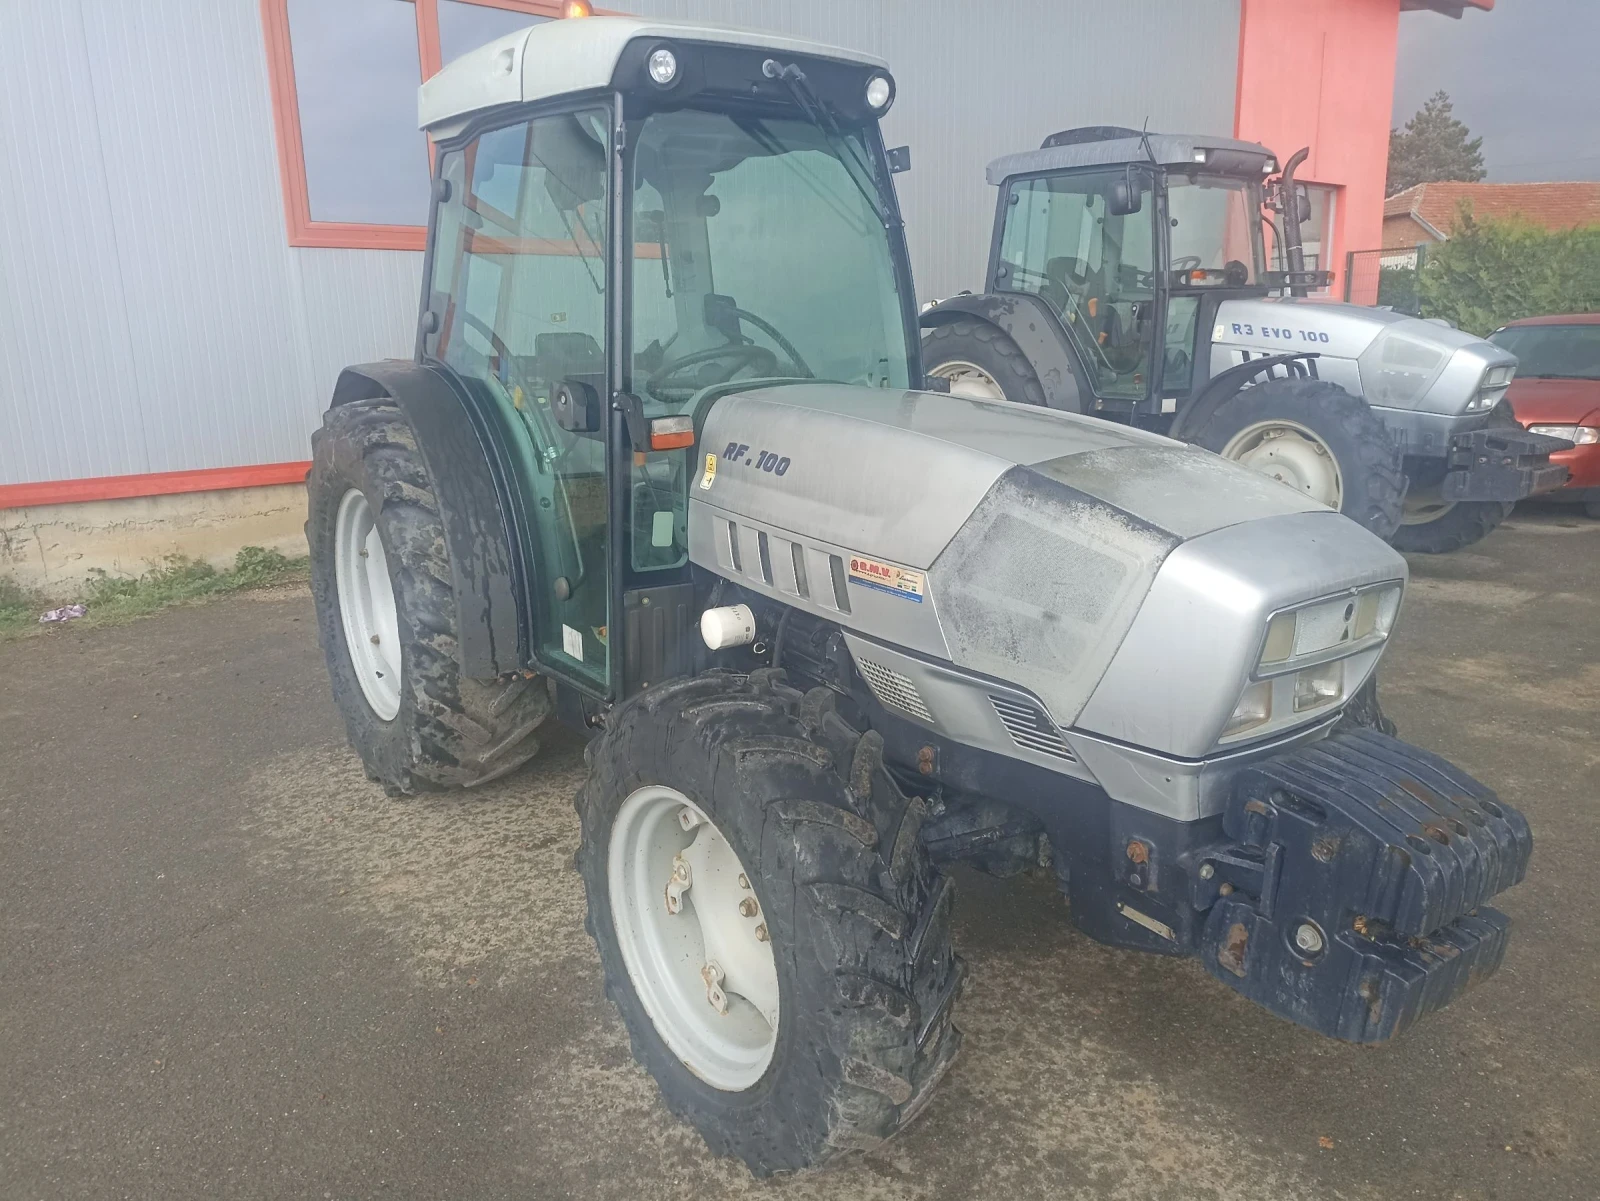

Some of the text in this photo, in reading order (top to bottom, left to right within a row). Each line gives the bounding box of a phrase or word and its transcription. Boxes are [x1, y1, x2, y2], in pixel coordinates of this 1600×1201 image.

[1231, 322, 1330, 344] R3 EVO 100
